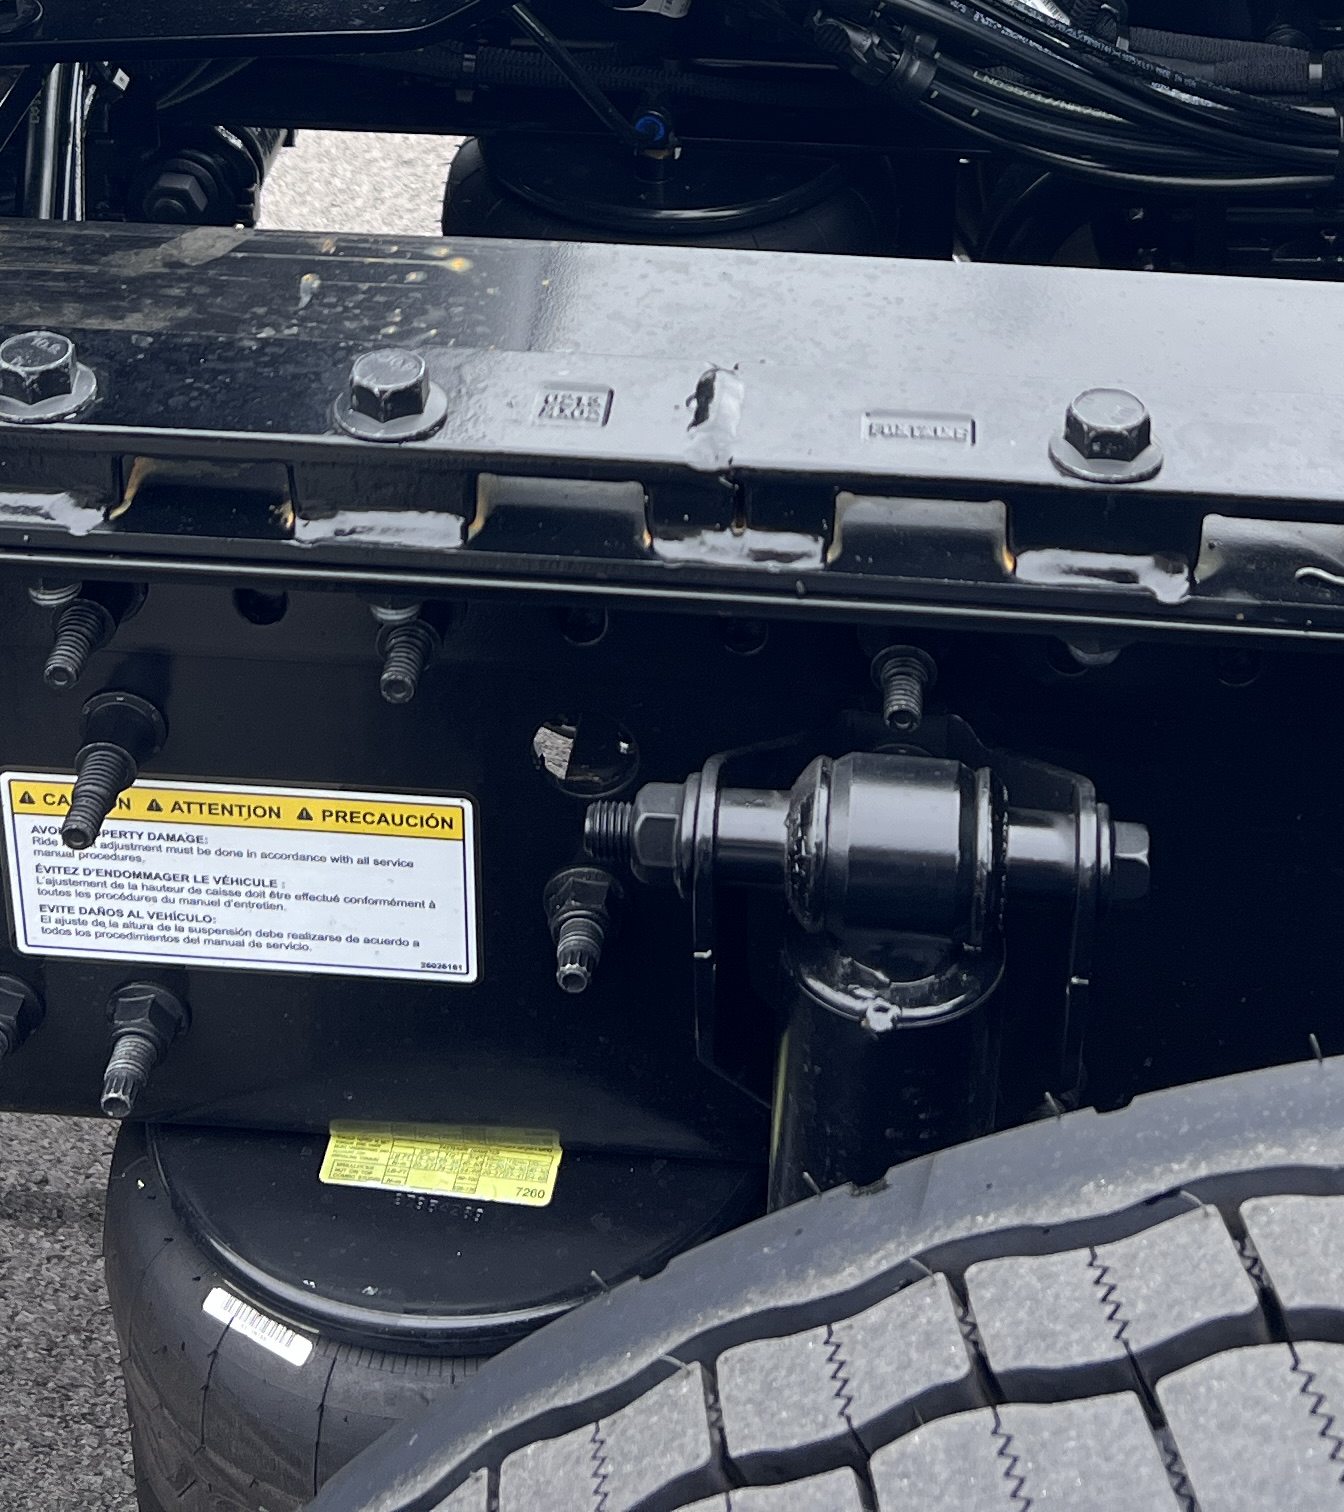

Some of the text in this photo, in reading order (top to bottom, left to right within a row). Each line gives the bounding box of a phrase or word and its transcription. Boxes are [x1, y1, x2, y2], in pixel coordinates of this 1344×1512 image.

[170, 799, 454, 830] ATTENTION PRECAUCIÓN
[147, 832, 208, 844] DAMAGE:
[32, 836, 58, 846] Ride
[100, 841, 162, 854] adjustment
[165, 845, 194, 856] must
[197, 847, 212, 856] be
[214, 848, 244, 858] done
[247, 849, 257, 858] in
[260, 851, 327, 863] accordance
[330, 854, 354, 865] with
[356, 856, 370, 865] all
[373, 858, 414, 868] service
[34, 849, 146, 864] manual procedures.
[35, 863, 79, 875] ÉVITEZ
[82, 867, 189, 884] D'ENDOMMAGER
[193, 874, 209, 884] LE
[213, 874, 278, 888] VÉHICULE
[36, 875, 107, 888] L'ajustement
[110, 879, 125, 889] de
[127, 880, 138, 890] la
[141, 882, 185, 893] hauteur
[188, 885, 202, 895] de
[205, 887, 241, 897] caisse
[244, 889, 266, 899] doit
[269, 890, 291, 900] être
[294, 892, 340, 903] effectué
[428, 899, 436, 909] à
[37, 887, 287, 912] toutes les procédures du manuel d'entretien.
[39, 904, 217, 924] EVITE DAÑOS AL VEHÍCULO:
[40, 915, 52, 924] El
[54, 916, 89, 929] ajuste
[91, 918, 106, 928] de
[108, 919, 119, 929] la
[122, 920, 154, 931] altura
[156, 922, 172, 932] de
[174, 924, 185, 933] la
[188, 926, 252, 938] suspensión
[255, 929, 284, 940] debe
[287, 931, 342, 942] realizarse
[345, 934, 360, 944] de
[363, 936, 409, 947] acuerdo
[41, 926, 312, 952] todos los procedimientos del manual de servicio.
